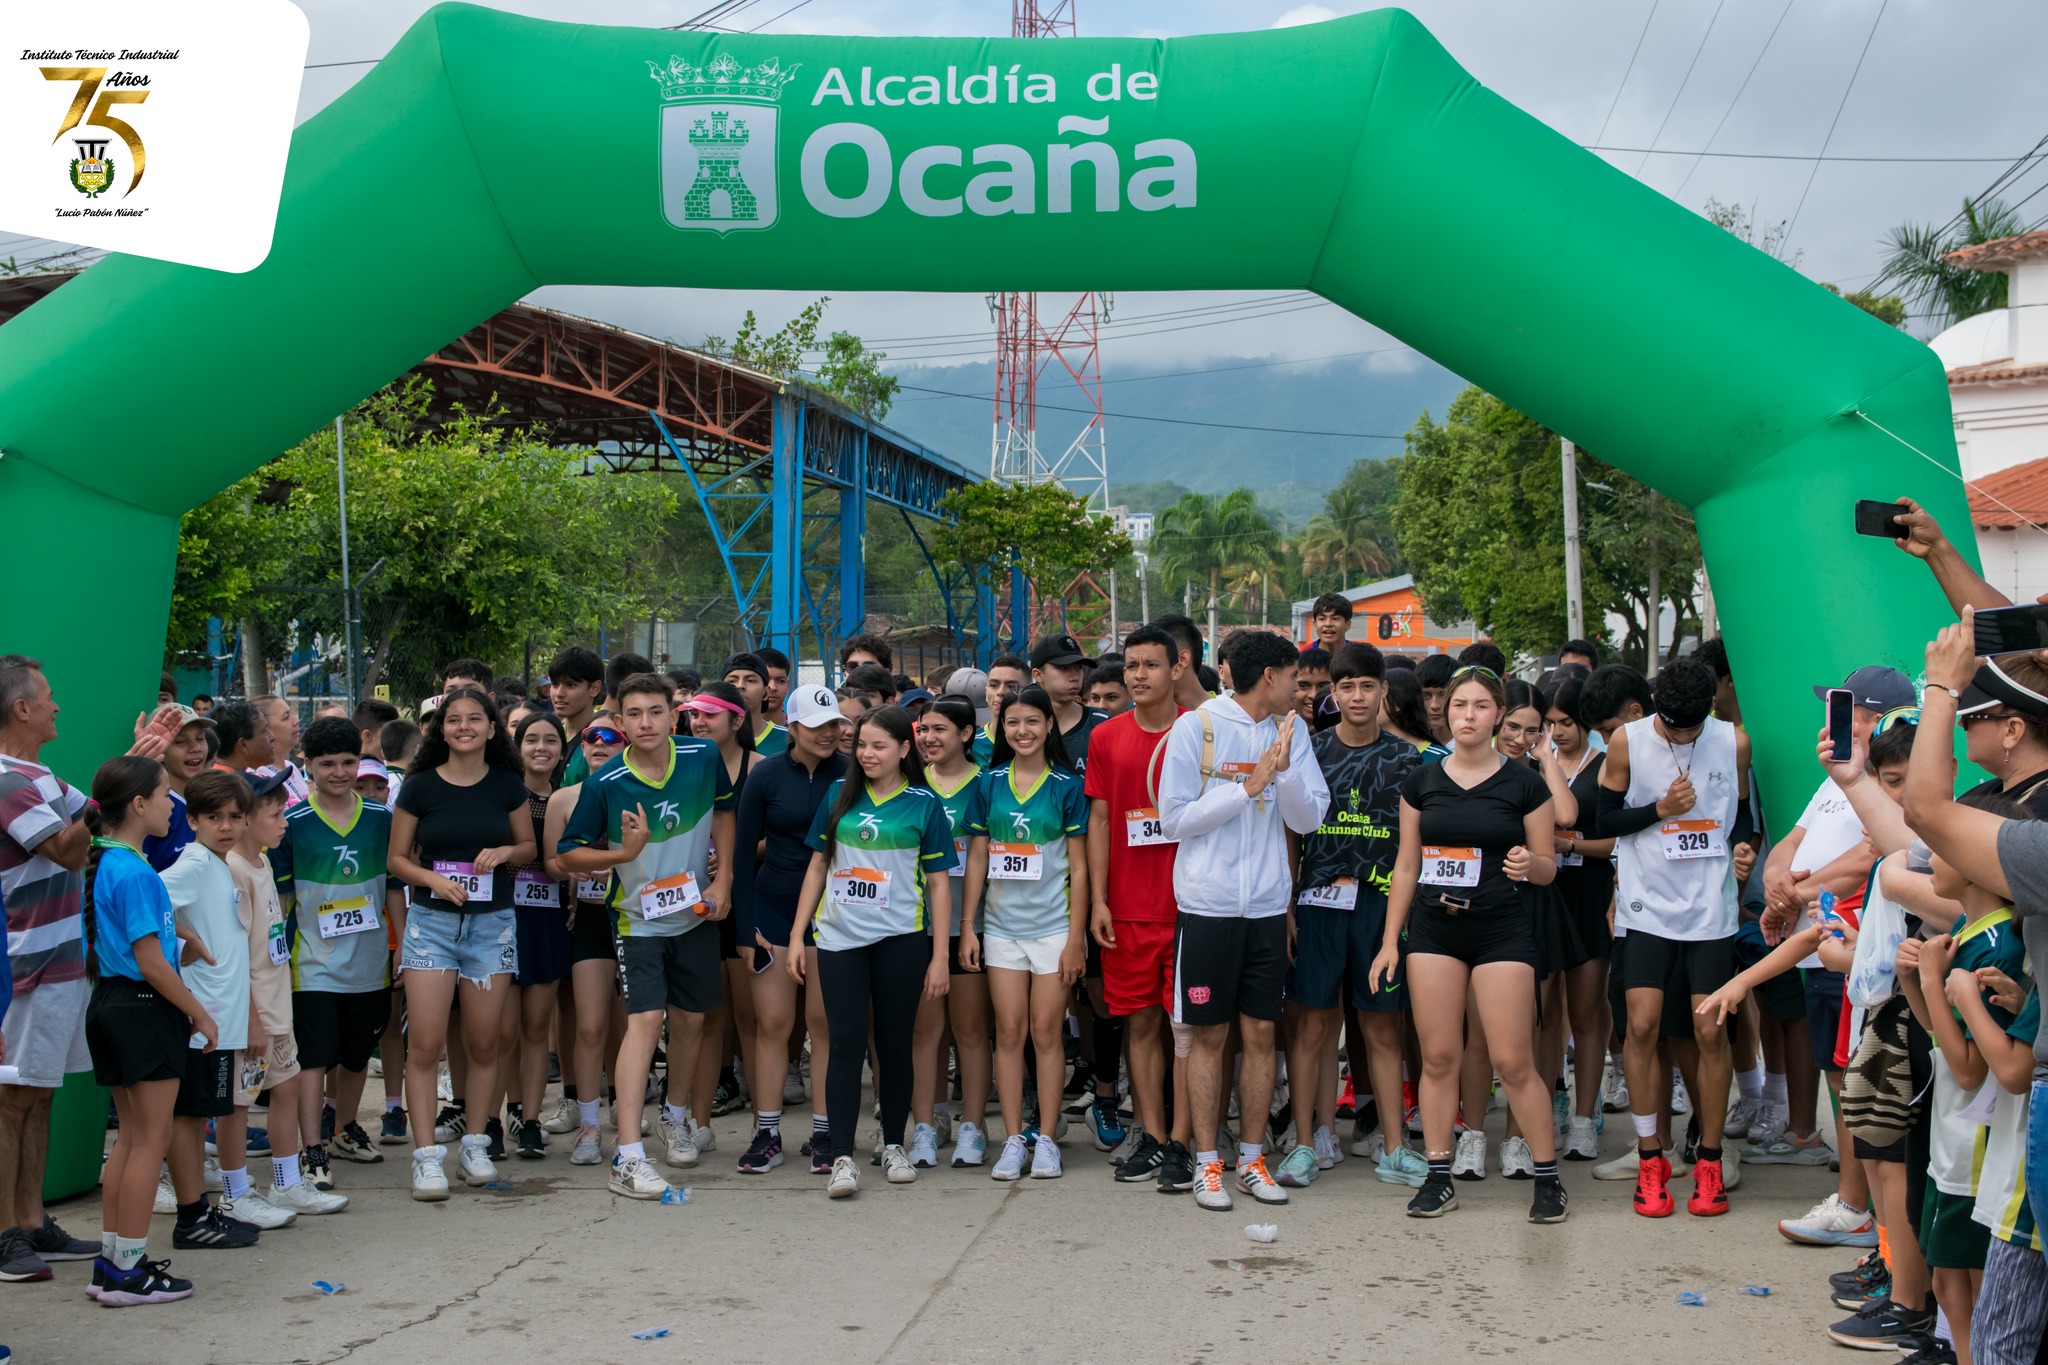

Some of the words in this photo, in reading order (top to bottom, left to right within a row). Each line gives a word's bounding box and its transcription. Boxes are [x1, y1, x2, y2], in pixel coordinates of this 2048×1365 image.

[811, 65, 1056, 106] Alcaldía
[1086, 63, 1158, 102] de
[800, 115, 1197, 218] Ocaña
[653, 800, 680, 828] 75
[857, 812, 883, 843] 75
[1009, 812, 1031, 840] 75
[1363, 825, 1390, 838] Club
[1678, 832, 1709, 851] 329
[333, 845, 359, 876] 75
[447, 863, 458, 871] km.
[1003, 856, 1028, 872] 351
[1436, 860, 1466, 878] 354
[449, 875, 479, 893] 256
[526, 883, 549, 900] 255
[847, 880, 877, 899] 300
[1312, 885, 1341, 901] 327
[656, 887, 686, 908] 324
[334, 910, 363, 929] 225
[217, 1061, 228, 1098] NIKE
